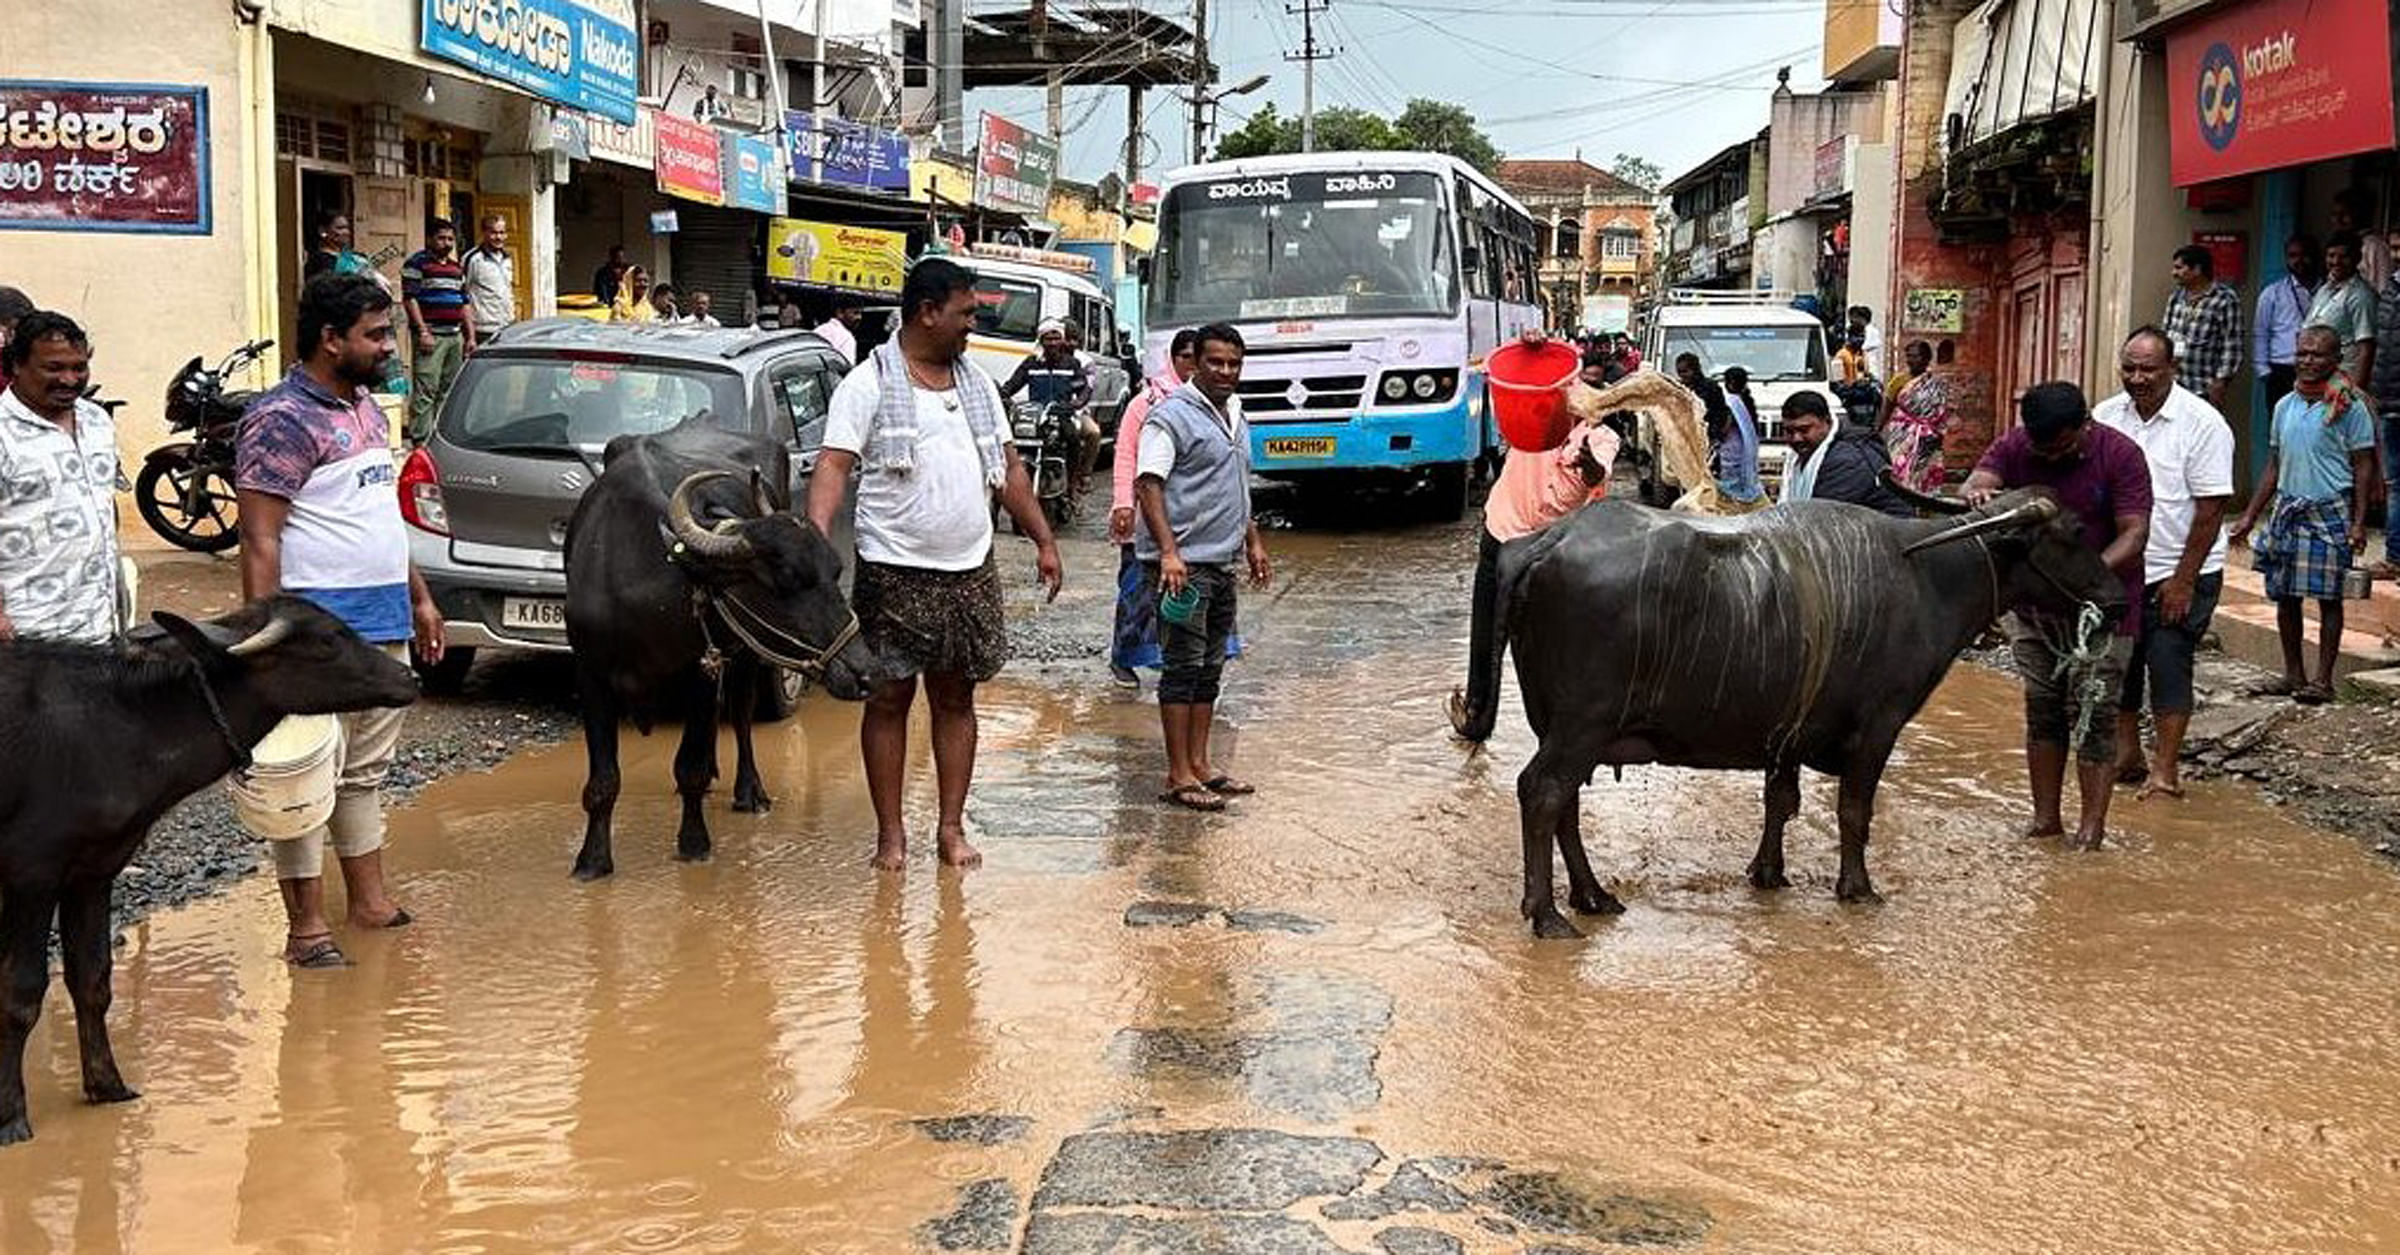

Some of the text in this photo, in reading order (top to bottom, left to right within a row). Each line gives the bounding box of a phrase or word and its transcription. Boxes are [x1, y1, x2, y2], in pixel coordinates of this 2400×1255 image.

[582, 17, 634, 81] Nakoda
[2243, 31, 2295, 78] kotak
[0, 101, 167, 164] ಟೇಶ್ವರ
[1325, 174, 1396, 192] ವಾಹಿನಿ
